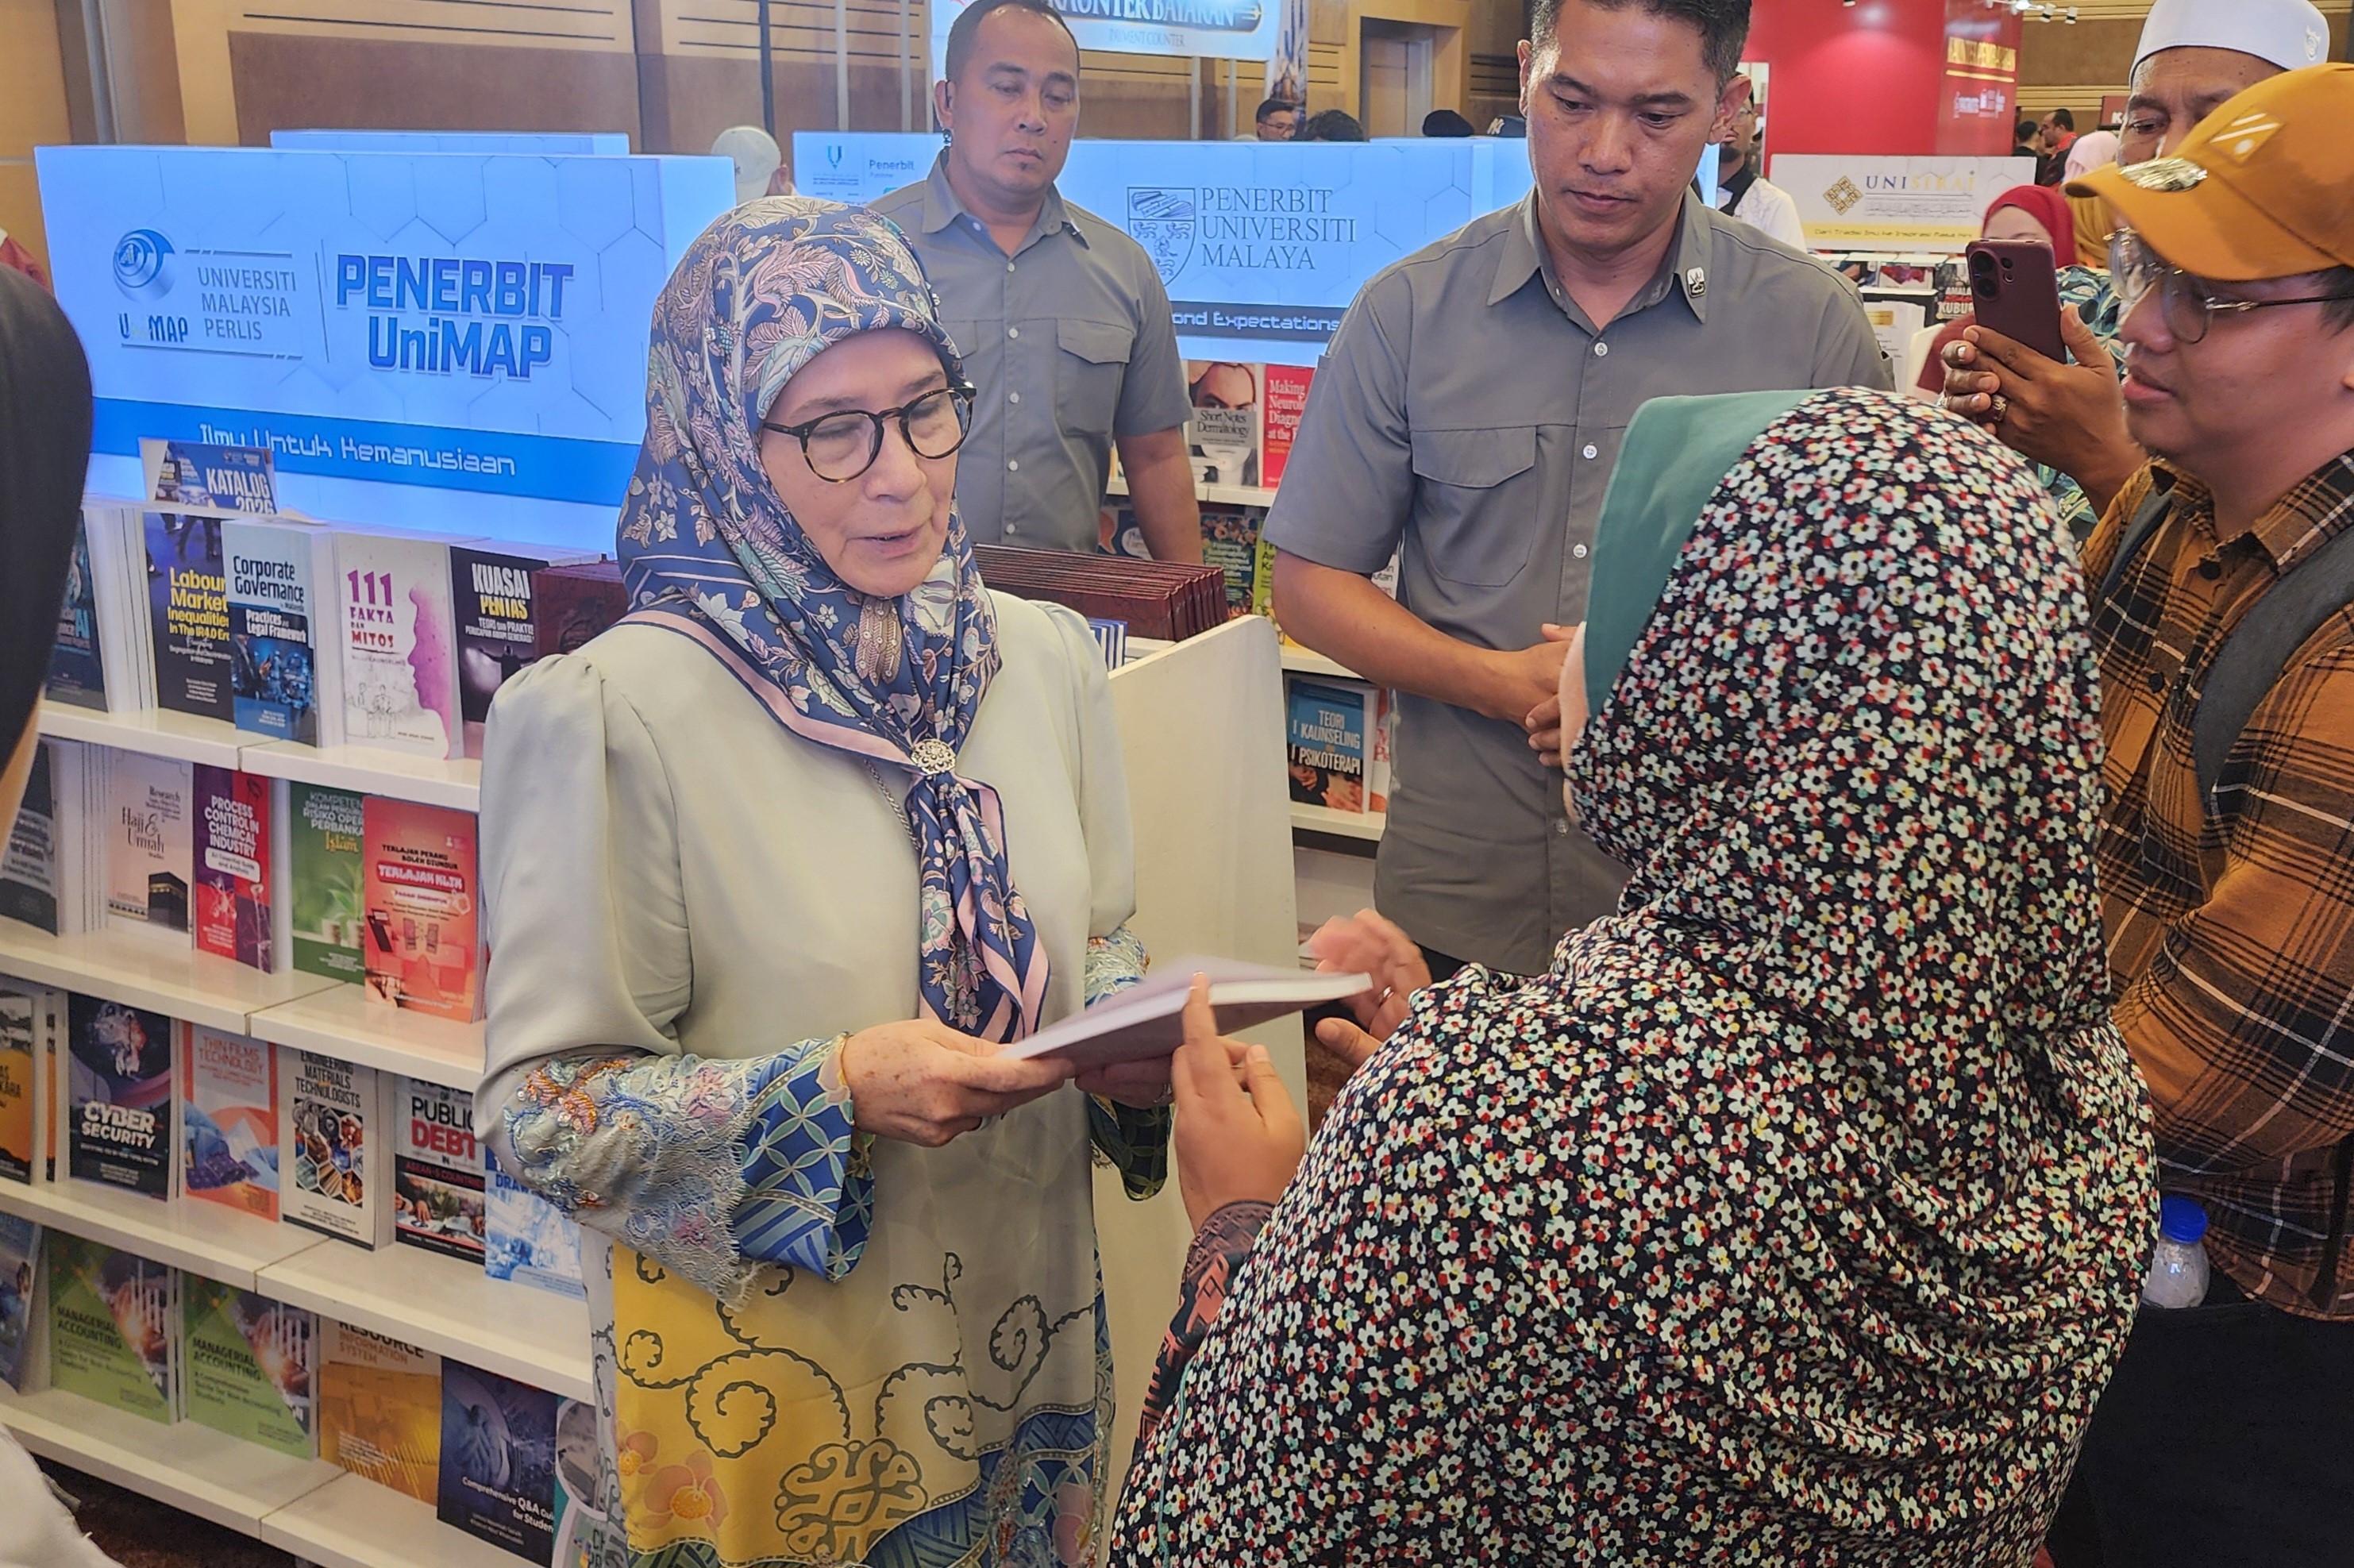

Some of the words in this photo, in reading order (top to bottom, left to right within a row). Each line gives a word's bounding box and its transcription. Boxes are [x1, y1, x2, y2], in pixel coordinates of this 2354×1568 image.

[869, 160, 915, 170] Penerbit
[1200, 187, 1334, 214] PENERBIT
[1201, 216, 1357, 243] UNIVERSITI
[1201, 244, 1316, 271] MALAYA
[198, 267, 297, 291] UNIVERSITI
[337, 254, 574, 320] PENERBIT
[202, 293, 291, 317] MALAYSIA
[119, 314, 188, 342] UMAP
[204, 318, 262, 340] PERLIS
[1213, 310, 1341, 331] Expectations
[369, 316, 553, 379] UniMAP
[1269, 379, 1305, 397] Making
[1200, 410, 1222, 422] Short
[1223, 410, 1246, 423] Notes
[1197, 422, 1250, 438] Dermatology
[200, 424, 246, 447] Ilmu
[254, 428, 333, 457] Untuk
[341, 437, 515, 476] Kemanusiaan
[206, 468, 271, 499] KATALOG
[236, 495, 275, 514] 2026
[170, 566, 225, 592] Labour
[233, 556, 295, 582] Corporate
[472, 563, 531, 599] KUASAI
[170, 588, 228, 613] Market
[235, 576, 304, 603] Governance
[347, 569, 393, 607] 111
[245, 608, 282, 626] Practices
[349, 606, 395, 624] FAKTA
[480, 594, 528, 620] PENTAS
[247, 622, 268, 638] Legal
[351, 630, 394, 648] MITOS
[1319, 710, 1346, 730] TEORI
[1300, 722, 1361, 749] KAUNSELING
[1299, 746, 1361, 775] PSIKOTERAPI
[122, 806, 144, 833] Hajj
[211, 794, 253, 819] PROCESS
[303, 807, 336, 822] RISIKO
[204, 807, 249, 830] CONTROL
[249, 819, 260, 834] IN
[208, 820, 256, 844] CHEMICAL
[128, 827, 164, 853] Umrah
[210, 834, 257, 858] INDUSTRY
[305, 1064, 351, 1090] MATERIALS
[295, 1077, 360, 1108] TECHNOLOGISTS
[83, 1100, 156, 1134] CYBER
[81, 1121, 156, 1150] SECURITY
[411, 1118, 476, 1161] DEBT
[56, 1305, 117, 1335] MANAGERIAL
[57, 1320, 122, 1349] ACCOUNTING
[193, 1337, 255, 1368] MANAGERIAL
[194, 1350, 261, 1381] ACCOUNTING
[340, 1342, 377, 1365] SYSTEM
[462, 1476, 517, 1506] Comprehensive
[517, 1497, 541, 1516] Q&A
[512, 1508, 524, 1521] for
